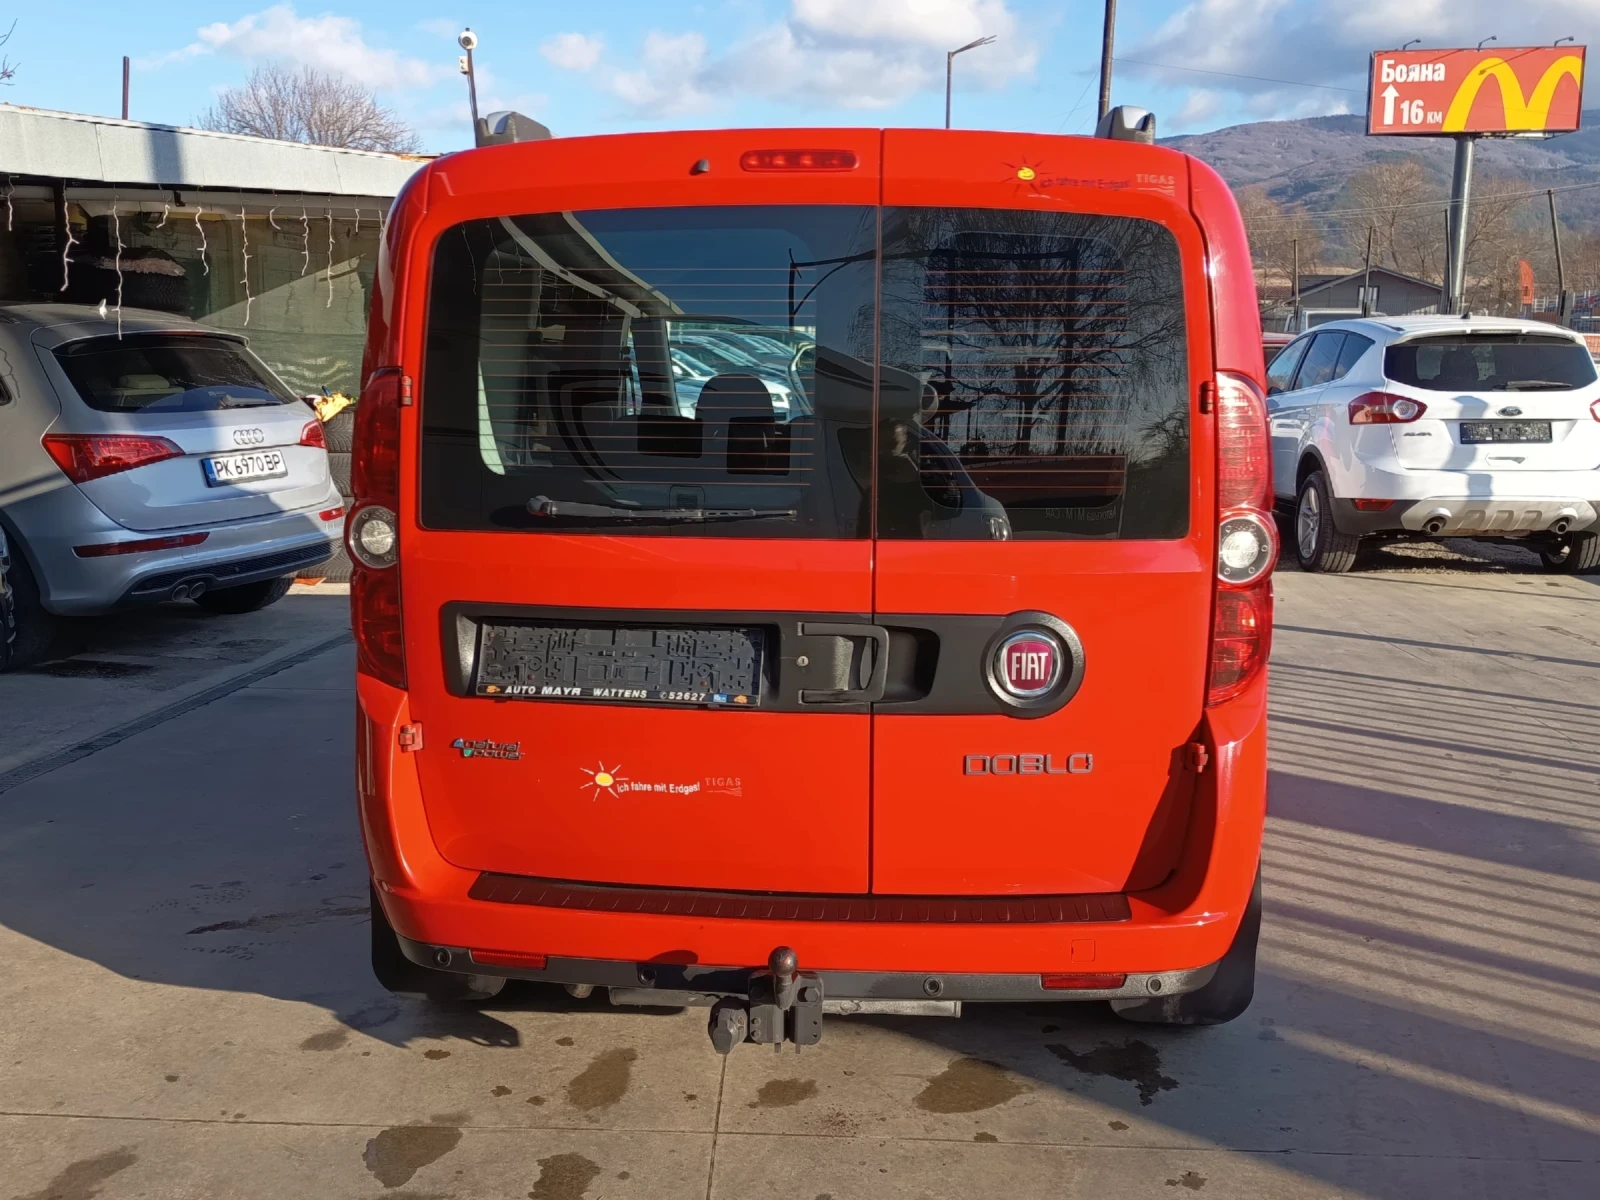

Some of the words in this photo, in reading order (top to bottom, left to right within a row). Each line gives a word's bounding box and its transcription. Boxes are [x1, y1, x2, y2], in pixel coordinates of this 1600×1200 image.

[1381, 59, 1446, 83] Бояна
[1400, 99, 1424, 125] 16
[1136, 173, 1175, 185] TIGAS
[214, 459, 232, 478] PK
[234, 456, 265, 475] 6970
[265, 453, 281, 471] BP
[1011, 652, 1049, 681] FIAT
[505, 685, 536, 695] AUTO
[541, 687, 581, 697] MAYR
[592, 688, 647, 699] WATTENS
[465, 739, 521, 753] natural
[630, 781, 652, 792] fahre
[653, 782, 668, 793] mit
[669, 781, 701, 796] Erdgas!
[704, 777, 741, 787] TIGAS
